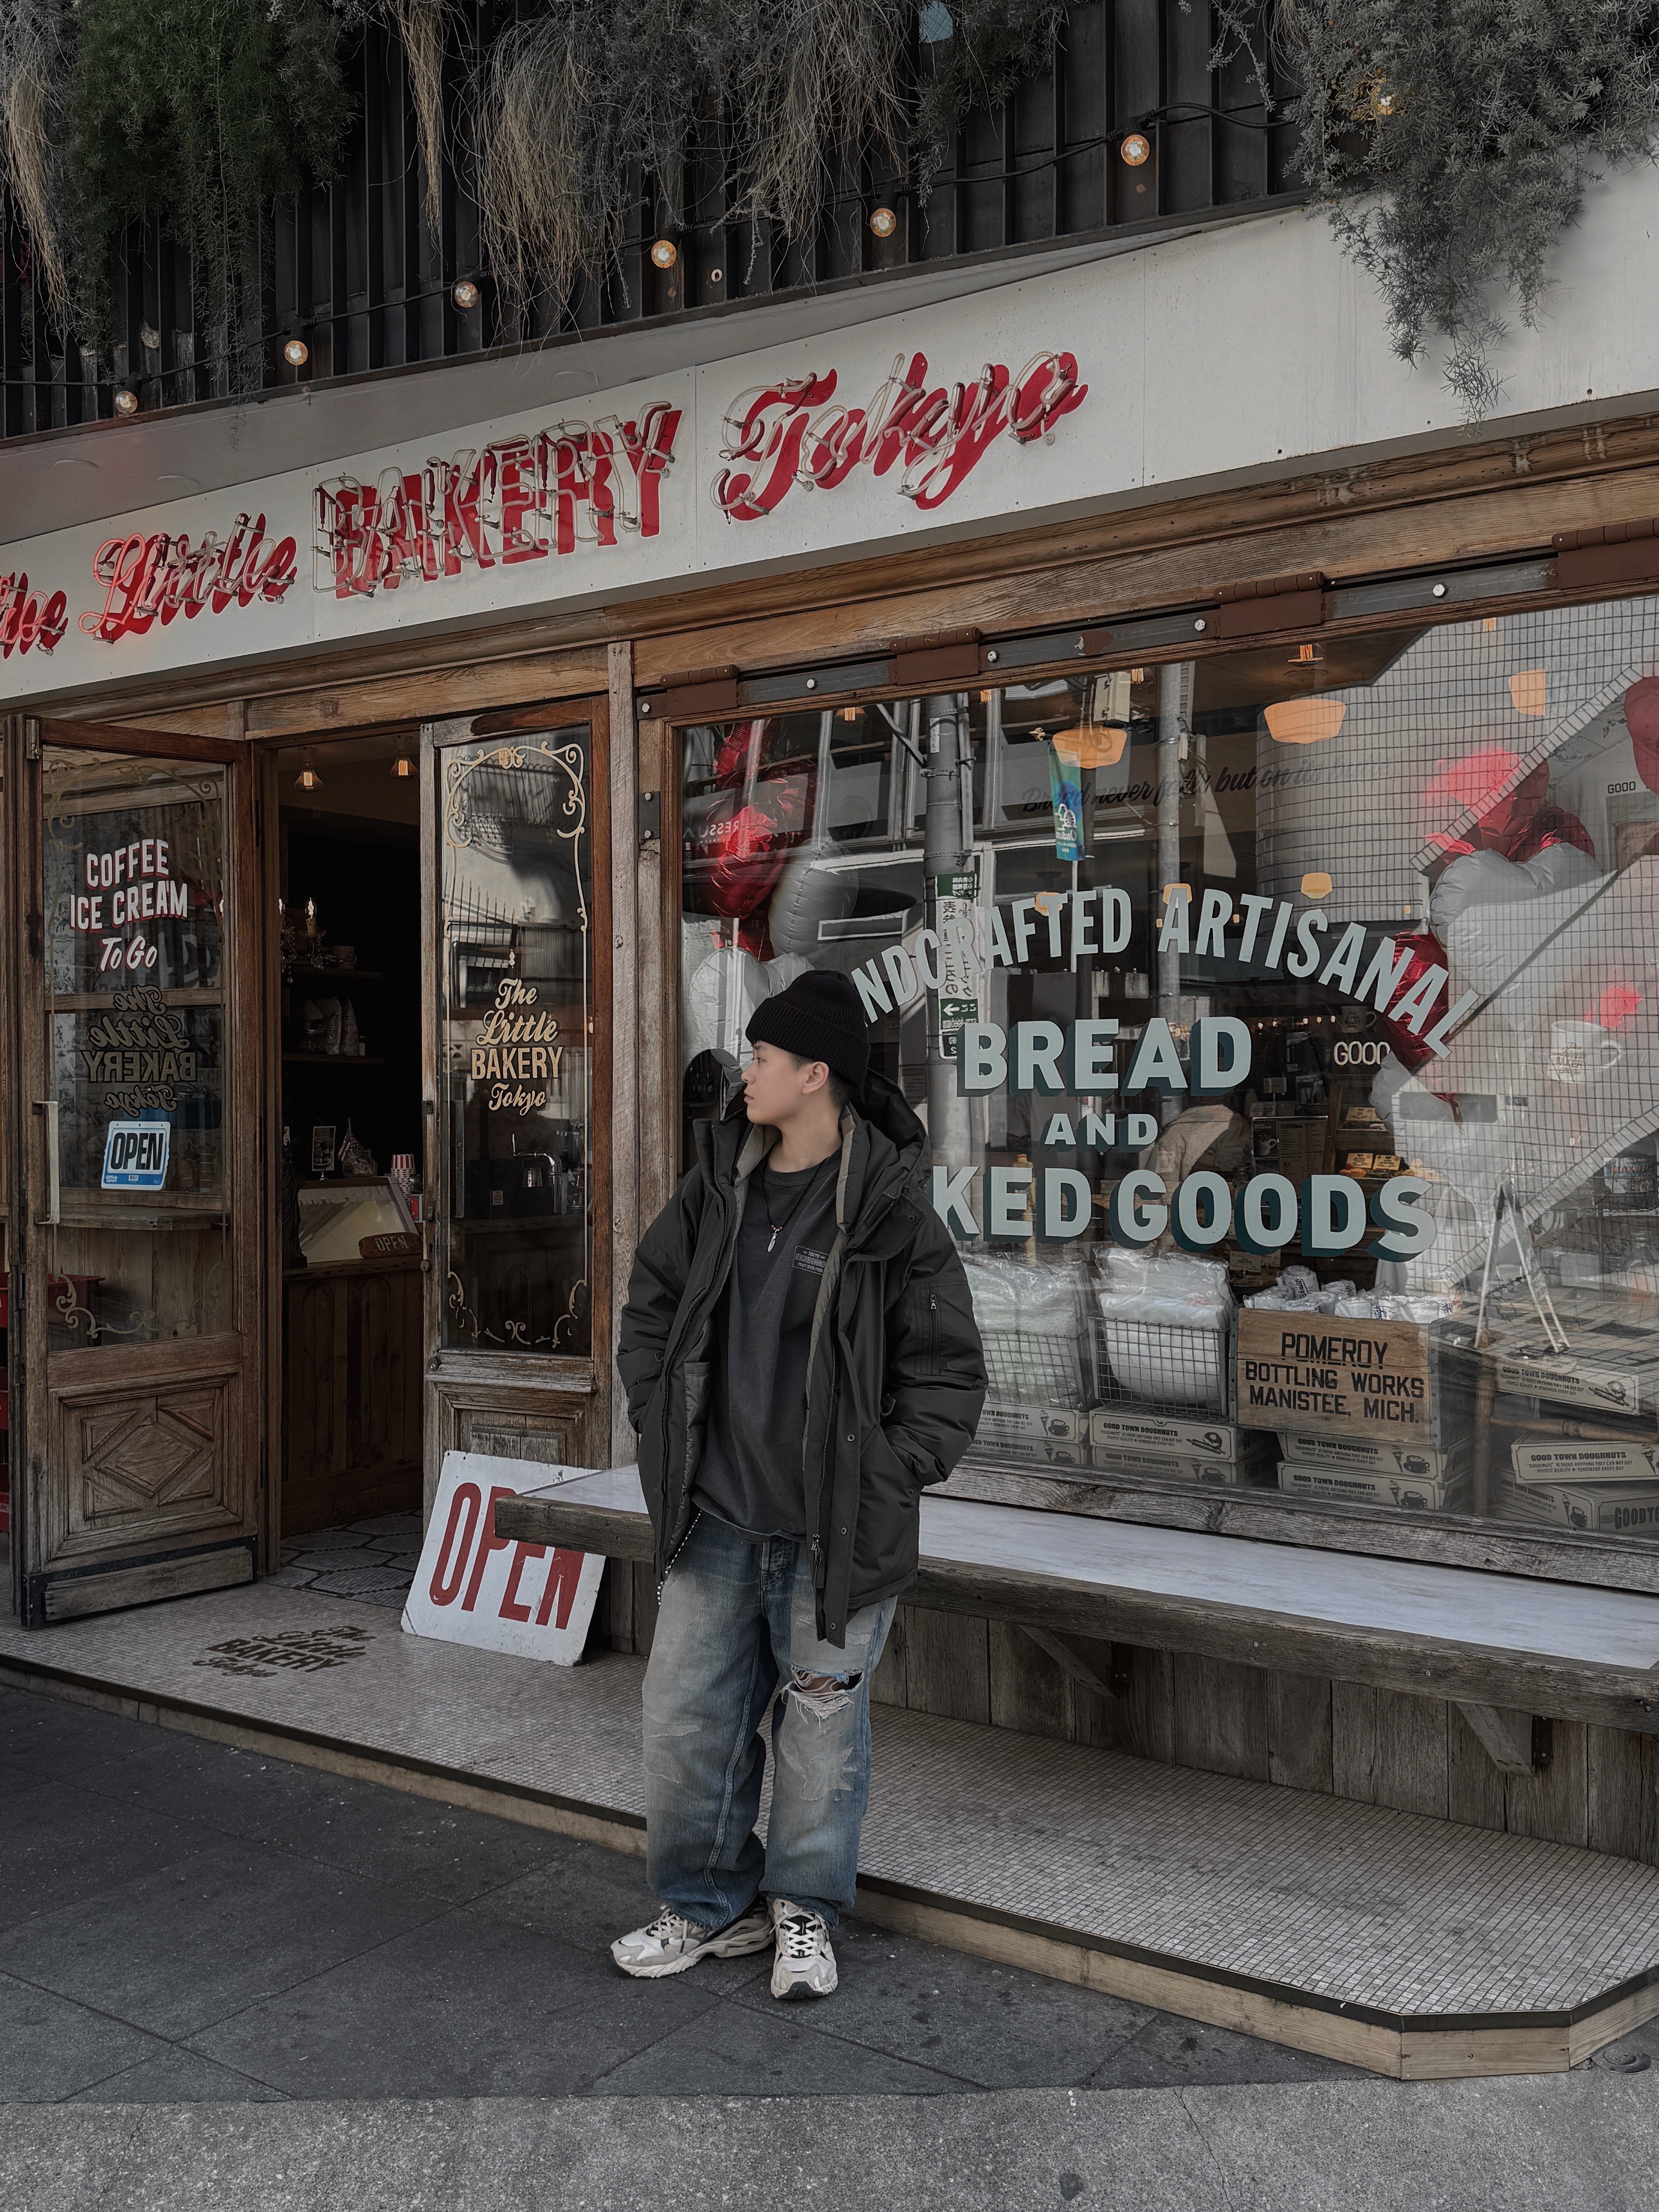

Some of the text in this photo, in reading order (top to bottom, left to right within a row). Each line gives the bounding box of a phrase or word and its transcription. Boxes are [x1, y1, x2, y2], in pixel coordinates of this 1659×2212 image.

[0, 352, 1088, 659] he Little BAKERY Tokyo
[1214, 766, 1257, 793] but
[1607, 781, 1636, 794] GOOD
[86, 838, 169, 888] COFFEE
[70, 882, 188, 933] ICE CREAM
[98, 936, 157, 973] To Go
[851, 889, 1480, 1058] NDCRAFTED ARTISANAL
[495, 978, 537, 1009] The
[477, 1009, 558, 1046] Little
[472, 1047, 563, 1080] BAKERY
[961, 1017, 1251, 1092] BREAD
[489, 1083, 546, 1116] Tokyo
[1042, 1114, 1158, 1148] AND
[111, 1132, 163, 1170] OPEN
[1611, 1164, 1652, 1175] MAXWE
[933, 1166, 1436, 1255] KED GOODS
[375, 1235, 409, 1251] OPEN
[1281, 1332, 1388, 1369] POMEROY
[1245, 1361, 1424, 1398] BOTTLING WORKS
[1503, 1366, 1580, 1384] GOOD TOWN DOUGHNUTS
[1249, 1385, 1420, 1423] MANISTEE, MICH.
[1121, 1424, 1139, 1432] TOWN
[1141, 1426, 1178, 1436] DOUGHNUTS
[1298, 1438, 1315, 1446] GOOD
[1338, 1443, 1379, 1455] DOUGHNUTS
[1142, 1457, 1180, 1468] DOUGHNUTS
[1579, 1452, 1627, 1460] DOUGHNUTS
[1313, 1477, 1333, 1485] TOWN
[1334, 1480, 1376, 1491] DOUGHNUTS
[1615, 1505, 1659, 1530] GOODTO
[429, 1482, 584, 1630] OPEN
[205, 1639, 348, 1673] BAKERY
